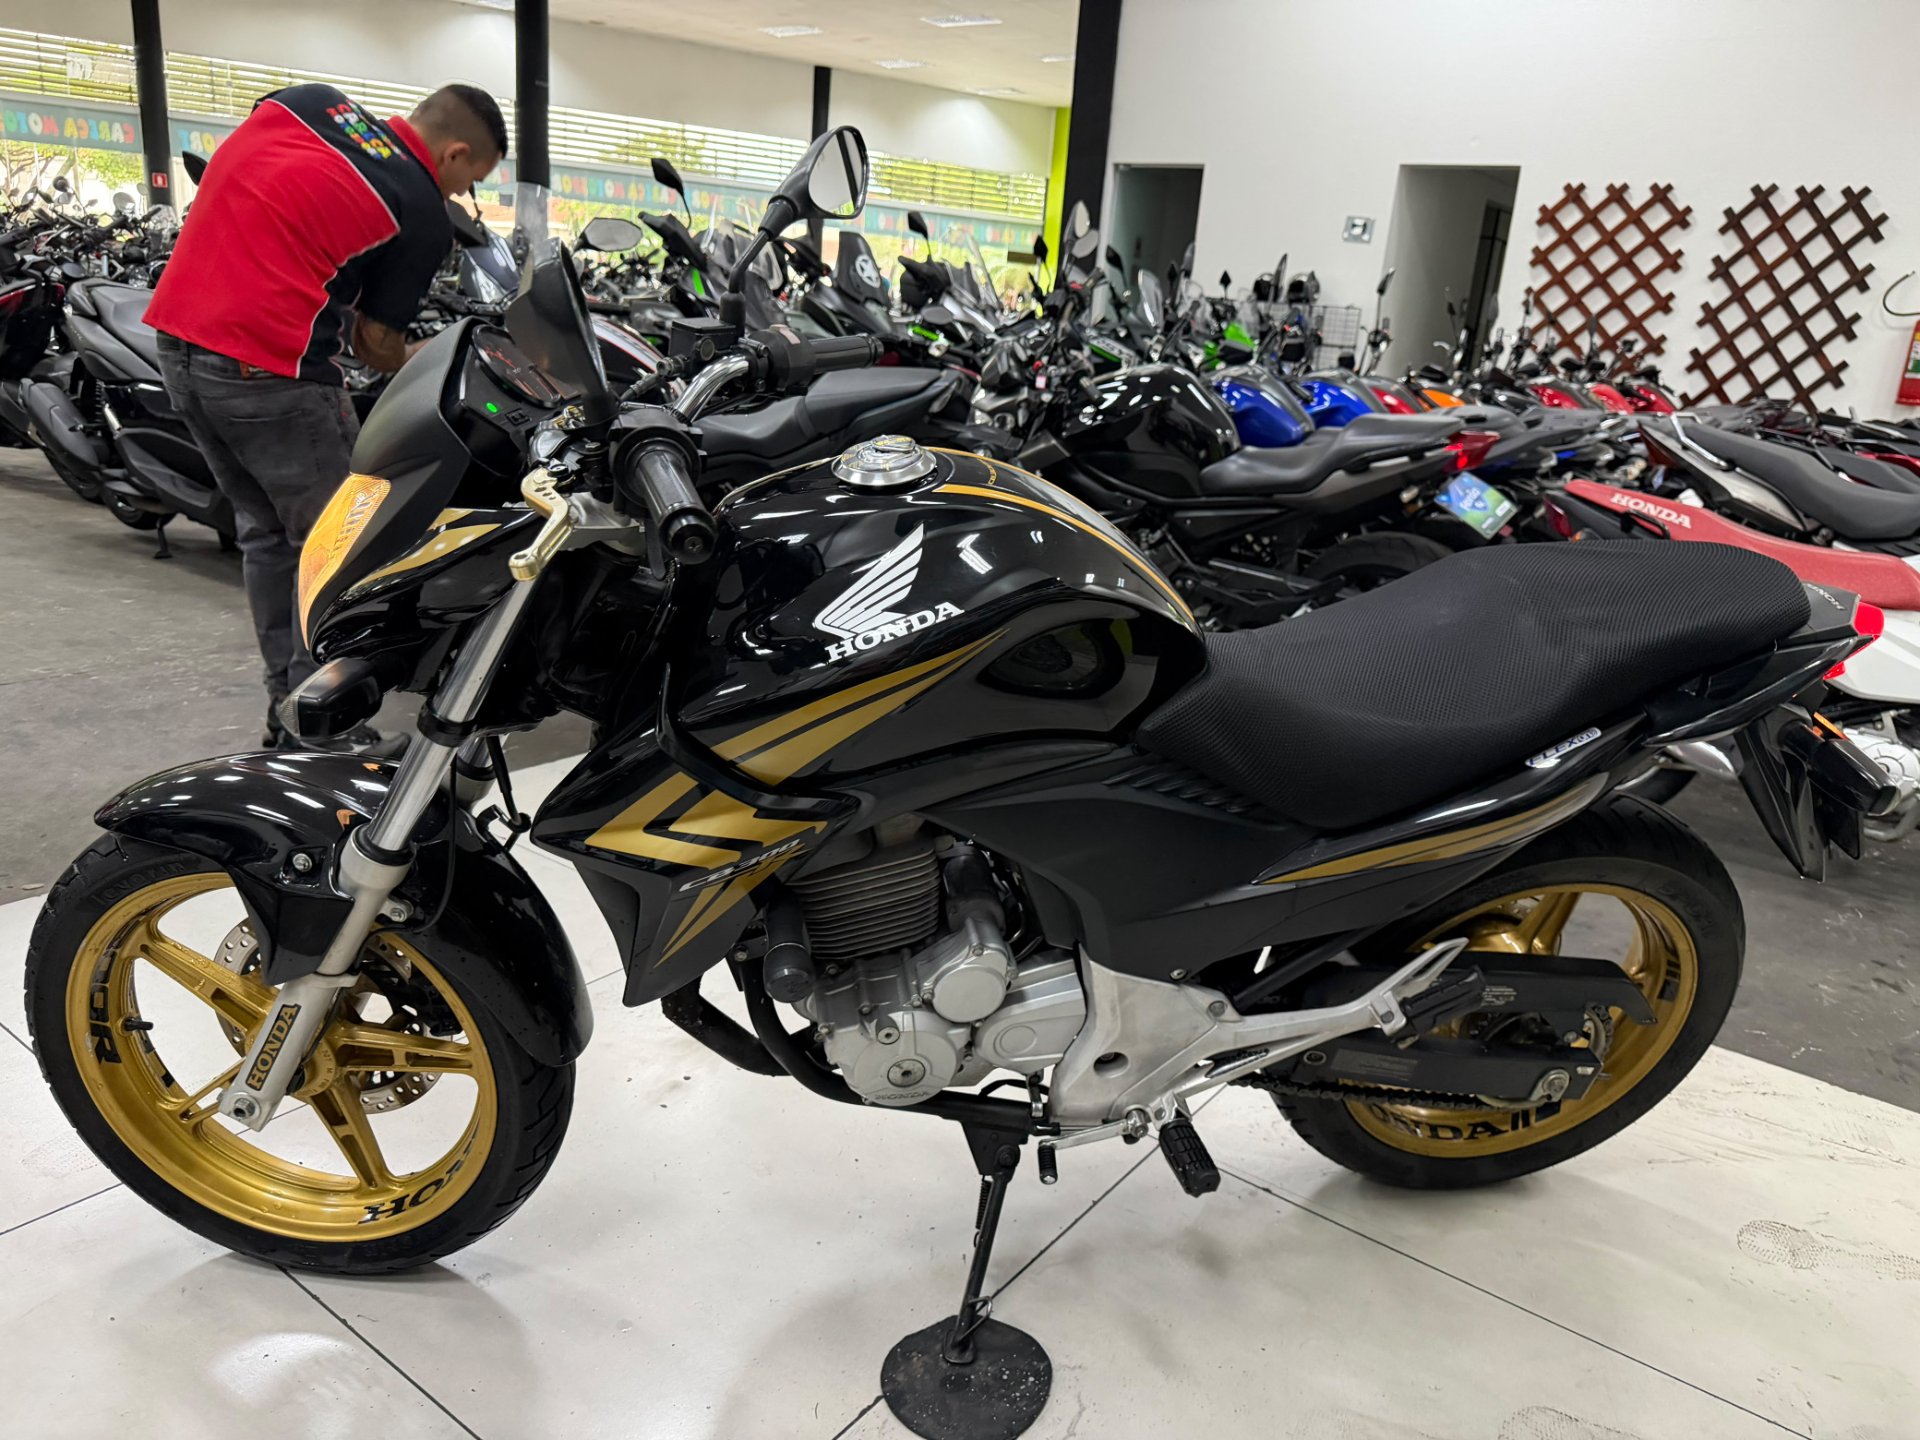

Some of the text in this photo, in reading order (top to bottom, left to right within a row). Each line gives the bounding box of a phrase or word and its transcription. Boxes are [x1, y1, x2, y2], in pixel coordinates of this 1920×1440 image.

[1610, 493, 1692, 529] HONDA
[824, 601, 965, 663] HONDA
[246, 1005, 300, 1090] HONDA
